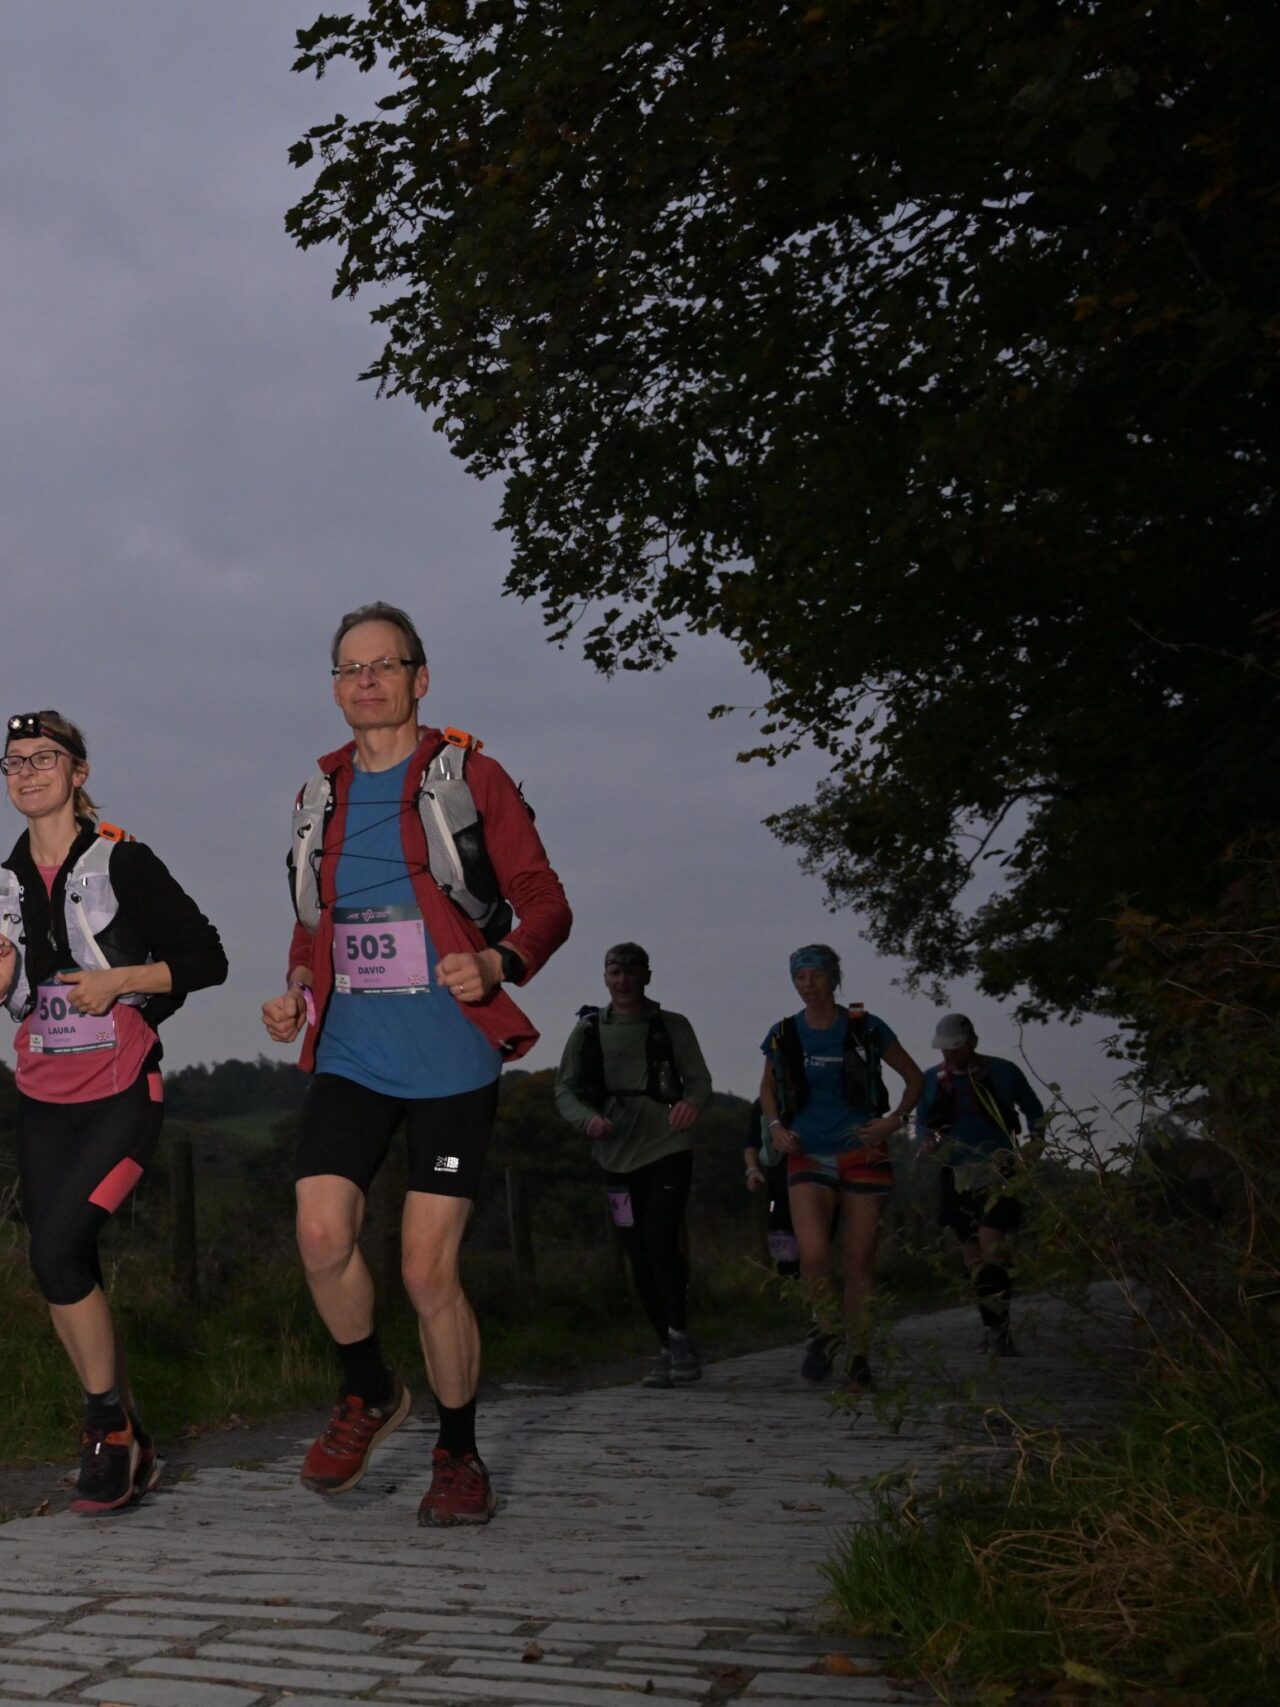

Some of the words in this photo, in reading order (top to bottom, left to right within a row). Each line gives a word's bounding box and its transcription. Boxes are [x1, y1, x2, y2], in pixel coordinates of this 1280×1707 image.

[346, 933, 397, 960] 503
[358, 966, 385, 975] DAVID
[48, 1025, 76, 1035] LAURA
